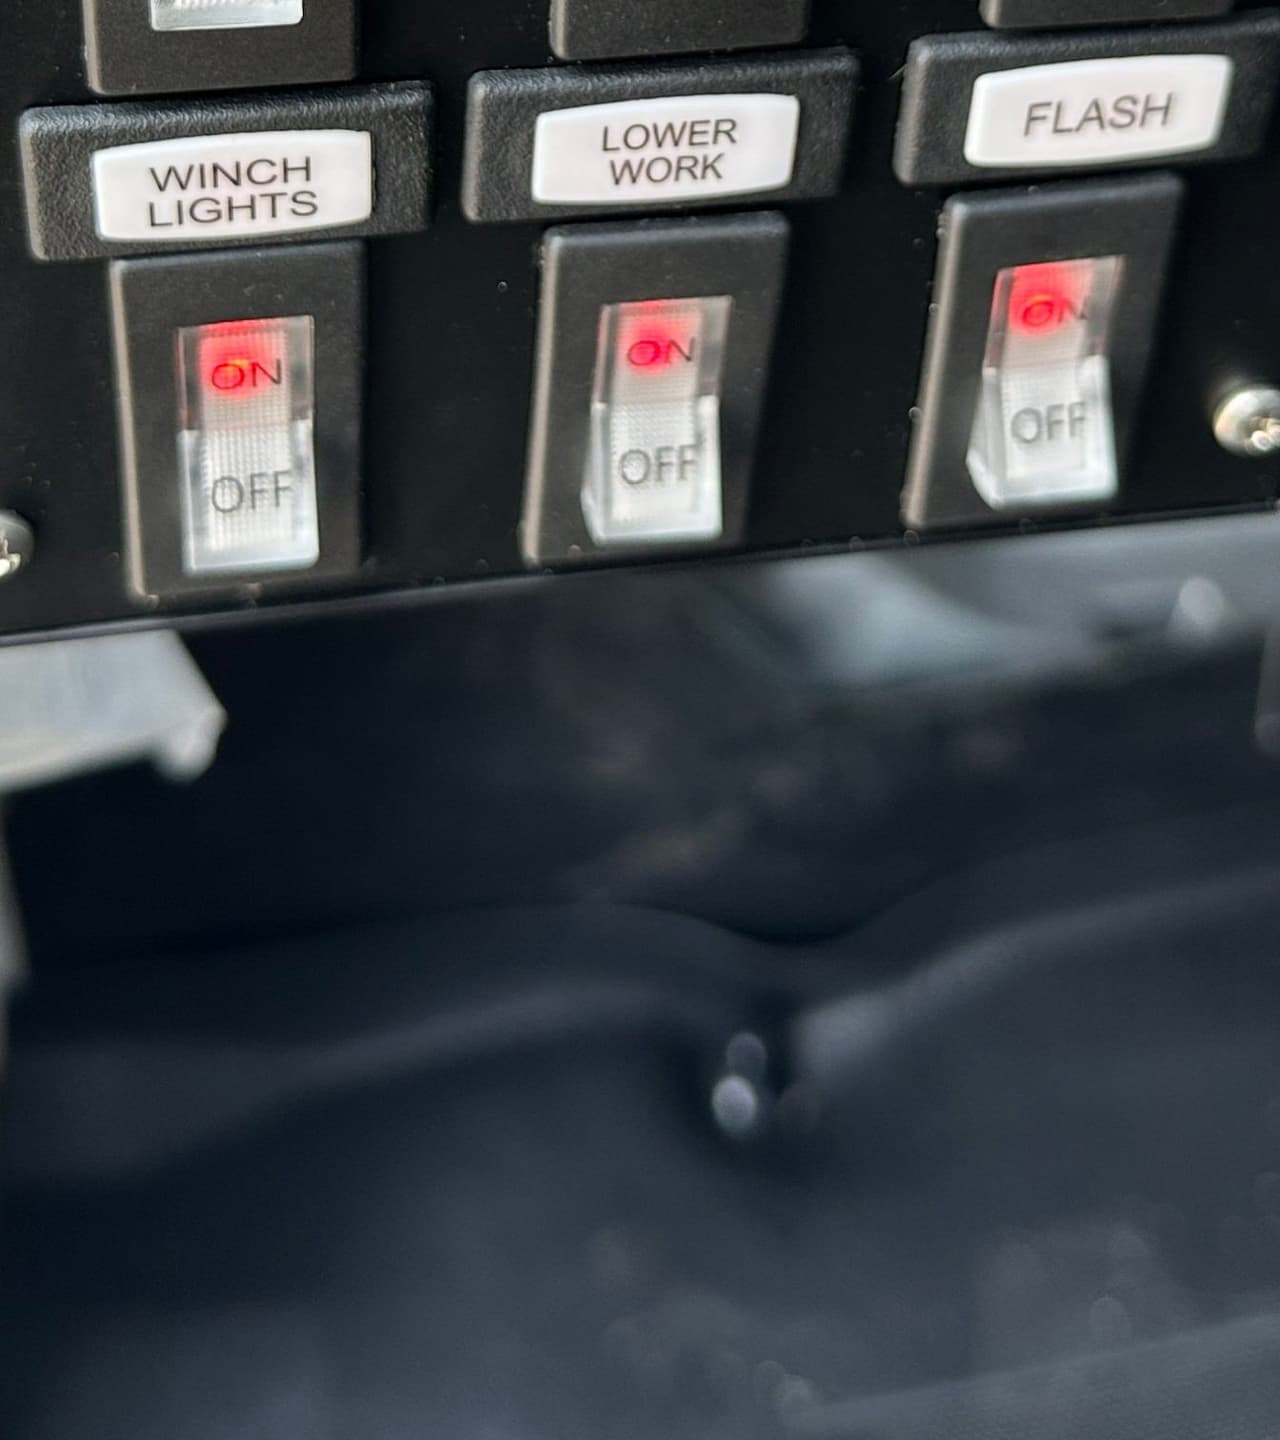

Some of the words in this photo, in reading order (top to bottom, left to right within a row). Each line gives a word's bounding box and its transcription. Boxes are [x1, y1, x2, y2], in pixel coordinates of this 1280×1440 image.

[1023, 92, 1172, 134] FLASH
[601, 118, 738, 151] LOWER
[149, 157, 312, 190] WINCH
[609, 151, 725, 185] WORK
[147, 188, 319, 227] LIGHTS
[1021, 296, 1089, 328] ON
[627, 335, 695, 370] ON
[211, 357, 283, 392] ON
[1010, 402, 1086, 443] OFF
[620, 444, 696, 485] OFF
[211, 472, 293, 513] OFF
